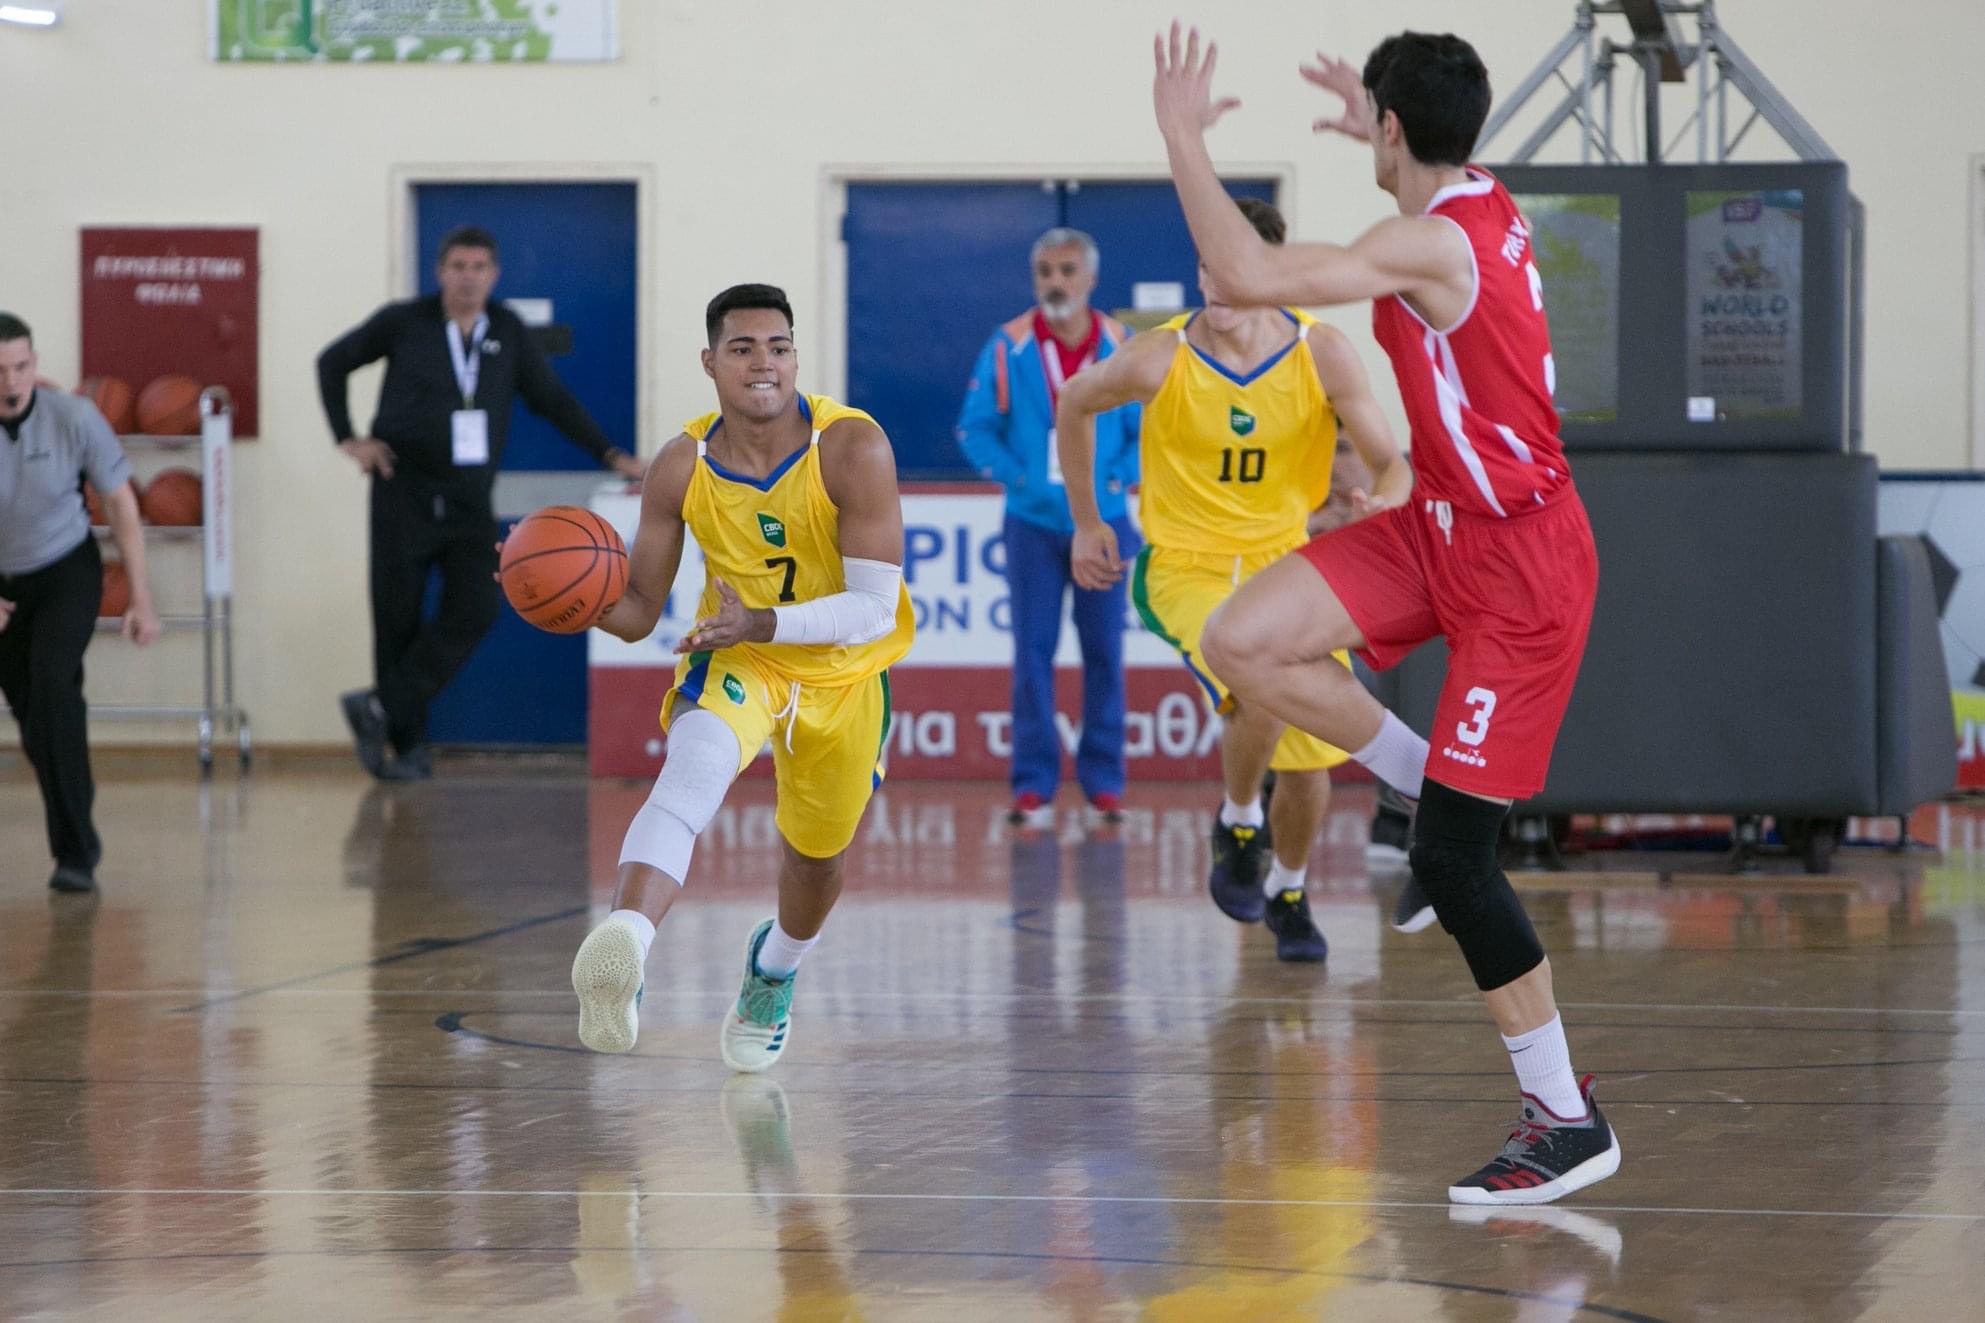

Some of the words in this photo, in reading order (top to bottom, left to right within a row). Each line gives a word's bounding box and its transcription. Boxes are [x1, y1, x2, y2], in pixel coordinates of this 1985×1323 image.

[1702, 294, 1789, 316] WORLD
[1701, 319, 1788, 336] SCHOOLS
[1218, 447, 1266, 482] 10
[765, 556, 797, 603] 7
[1456, 686, 1497, 747] 3
